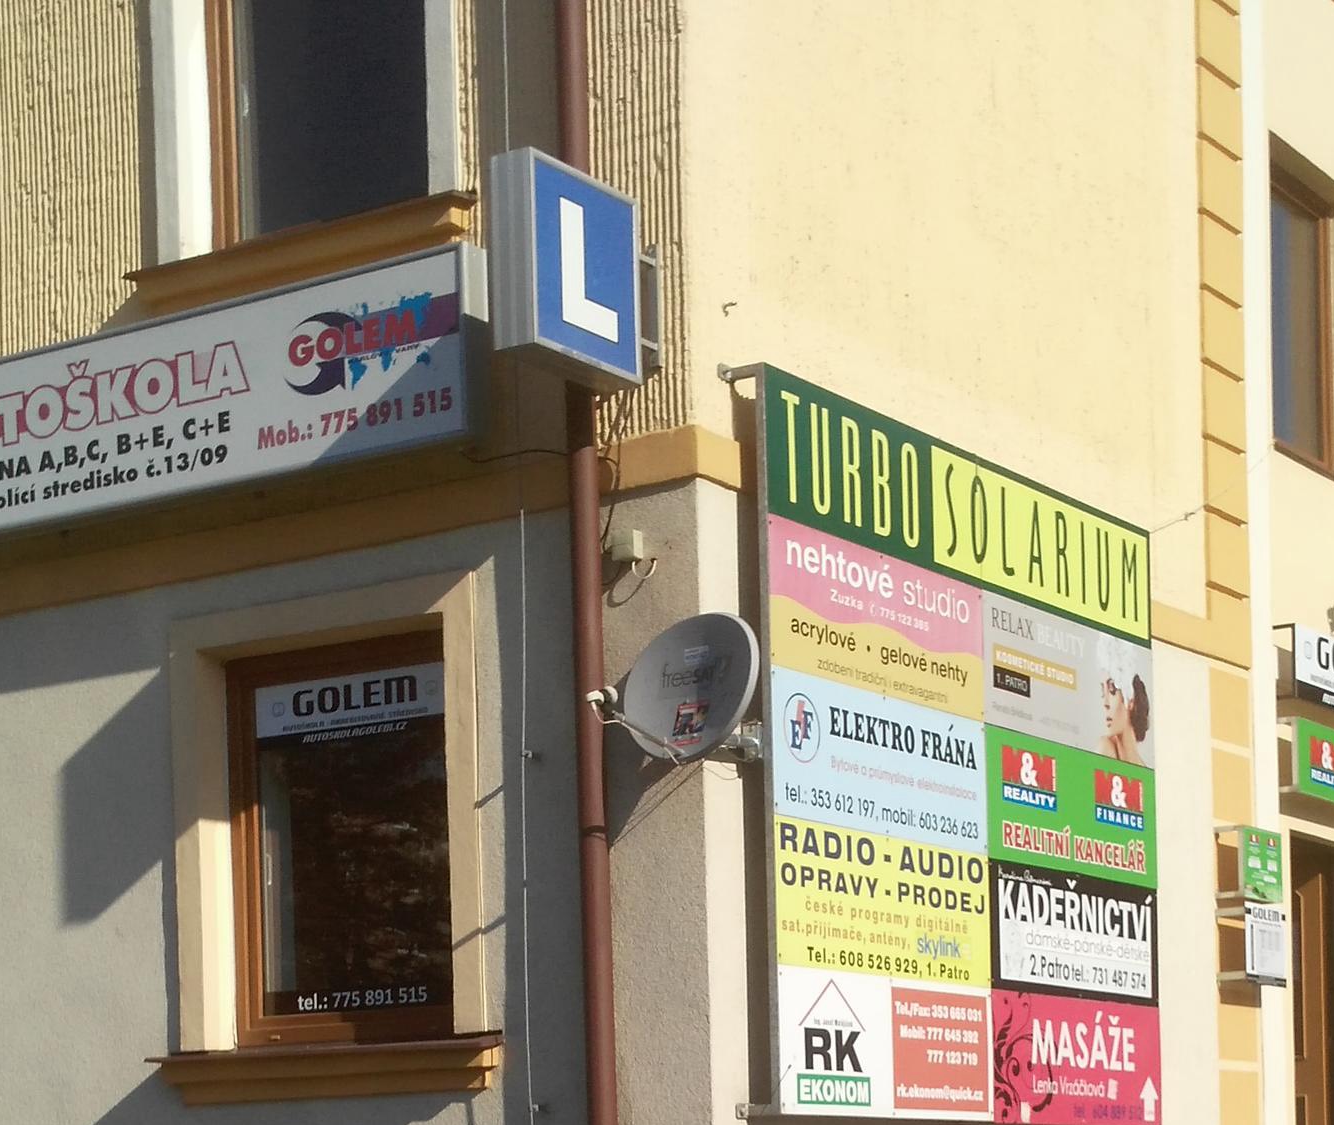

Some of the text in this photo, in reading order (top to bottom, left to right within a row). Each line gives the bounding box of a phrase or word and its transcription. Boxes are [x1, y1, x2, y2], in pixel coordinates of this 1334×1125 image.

[559, 196, 619, 344] L
[288, 309, 416, 367] GOLEM
[116, 425, 174, 456] B+E,
[182, 411, 231, 441] C+E
[257, 386, 452, 450] Mob.: 775 891 515
[780, 390, 1139, 623] TURBO SOLARIUM
[786, 539, 970, 623] nehtové studio
[830, 589, 863, 610] Zuzka
[991, 607, 1034, 641] RELAX
[791, 618, 968, 687] acrylové gelové nehty
[292, 675, 417, 718] GOLEM
[829, 706, 978, 771] ELEKTRO FRÁNA
[785, 782, 807, 805] tel.:
[811, 788, 831, 809] 353
[835, 793, 853, 814] 612
[881, 806, 916, 828] mobil:
[919, 811, 938, 832] 603
[940, 815, 958, 836] 236
[961, 819, 978, 840] 623
[1003, 785, 1055, 808] REALITY
[1097, 807, 1143, 829] FINANCE
[780, 822, 875, 865] RADIO
[899, 846, 984, 884] AUDIO
[1003, 821, 1146, 875] REALITNÍ KANCELÁŘ
[781, 862, 878, 898] OPRAVY
[898, 882, 985, 915] PRODEJ
[998, 879, 1152, 942] KADEŘNICTVÍ
[805, 896, 910, 930] české programy
[1253, 907, 1280, 923] GOLEM
[807, 947, 970, 981] Tel.: 608 526 929, 1. Patro
[917, 933, 961, 960] skylink
[297, 986, 427, 1011] tel.: 775 891 515
[1092, 967, 1108, 985] 731
[1131, 973, 1146, 990] 574
[804, 1027, 863, 1073] RK
[927, 1027, 943, 1041] 777
[1032, 1010, 1135, 1072] MASÁŽE
[927, 1050, 944, 1064] 777
[799, 1078, 869, 1104] EKONOM
[1033, 1075, 1058, 1094] Lenka
